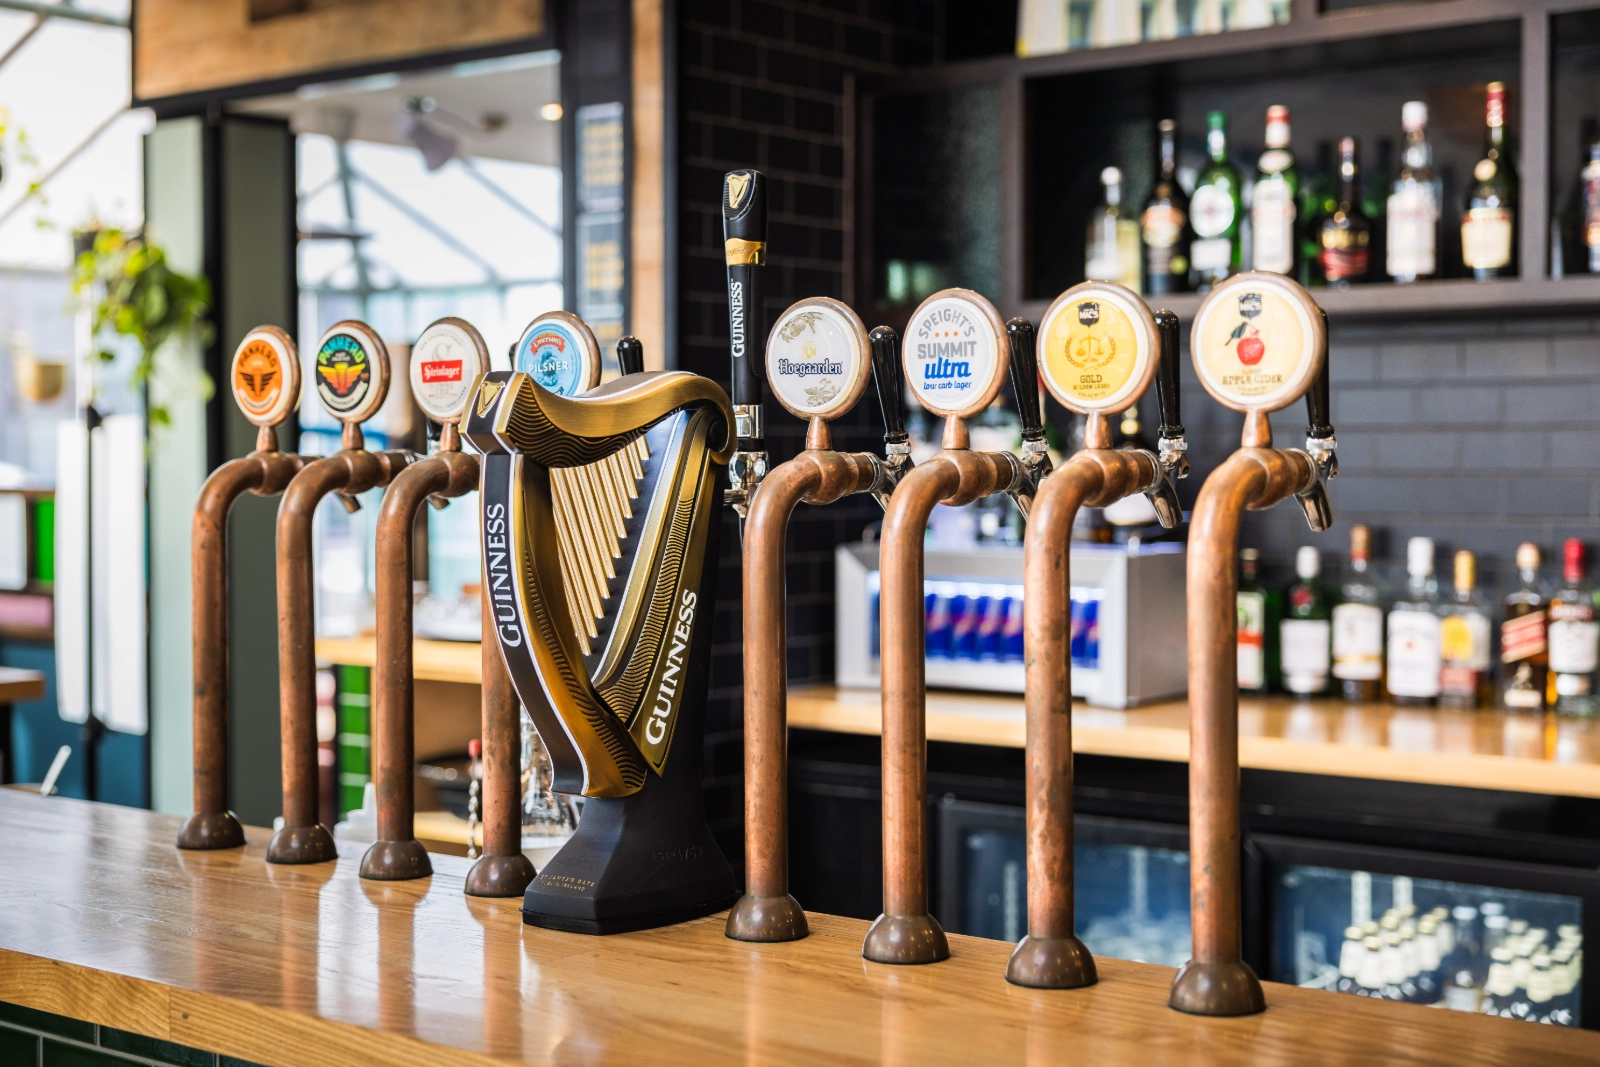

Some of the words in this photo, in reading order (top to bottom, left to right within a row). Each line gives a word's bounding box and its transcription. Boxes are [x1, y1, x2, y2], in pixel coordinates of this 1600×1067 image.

[731, 281, 745, 357] GUINNESS
[918, 308, 976, 339] SPEIGHT'S
[317, 336, 365, 365] PANHEAD
[533, 336, 562, 348] Emerson's
[917, 341, 978, 359] SUMMIT
[423, 364, 461, 380] Steinlager
[528, 360, 570, 373] PILSNER
[778, 357, 843, 378] Hoegaarden
[924, 356, 972, 379] ultra
[923, 381, 937, 390] low
[938, 380, 953, 390] carb
[953, 380, 973, 391] lager
[1080, 374, 1103, 384] GOLD
[1222, 375, 1252, 385] APPLE
[1254, 374, 1283, 384] CIDER
[486, 502, 522, 648] GUINNESS
[645, 588, 698, 745] GUINNESS
